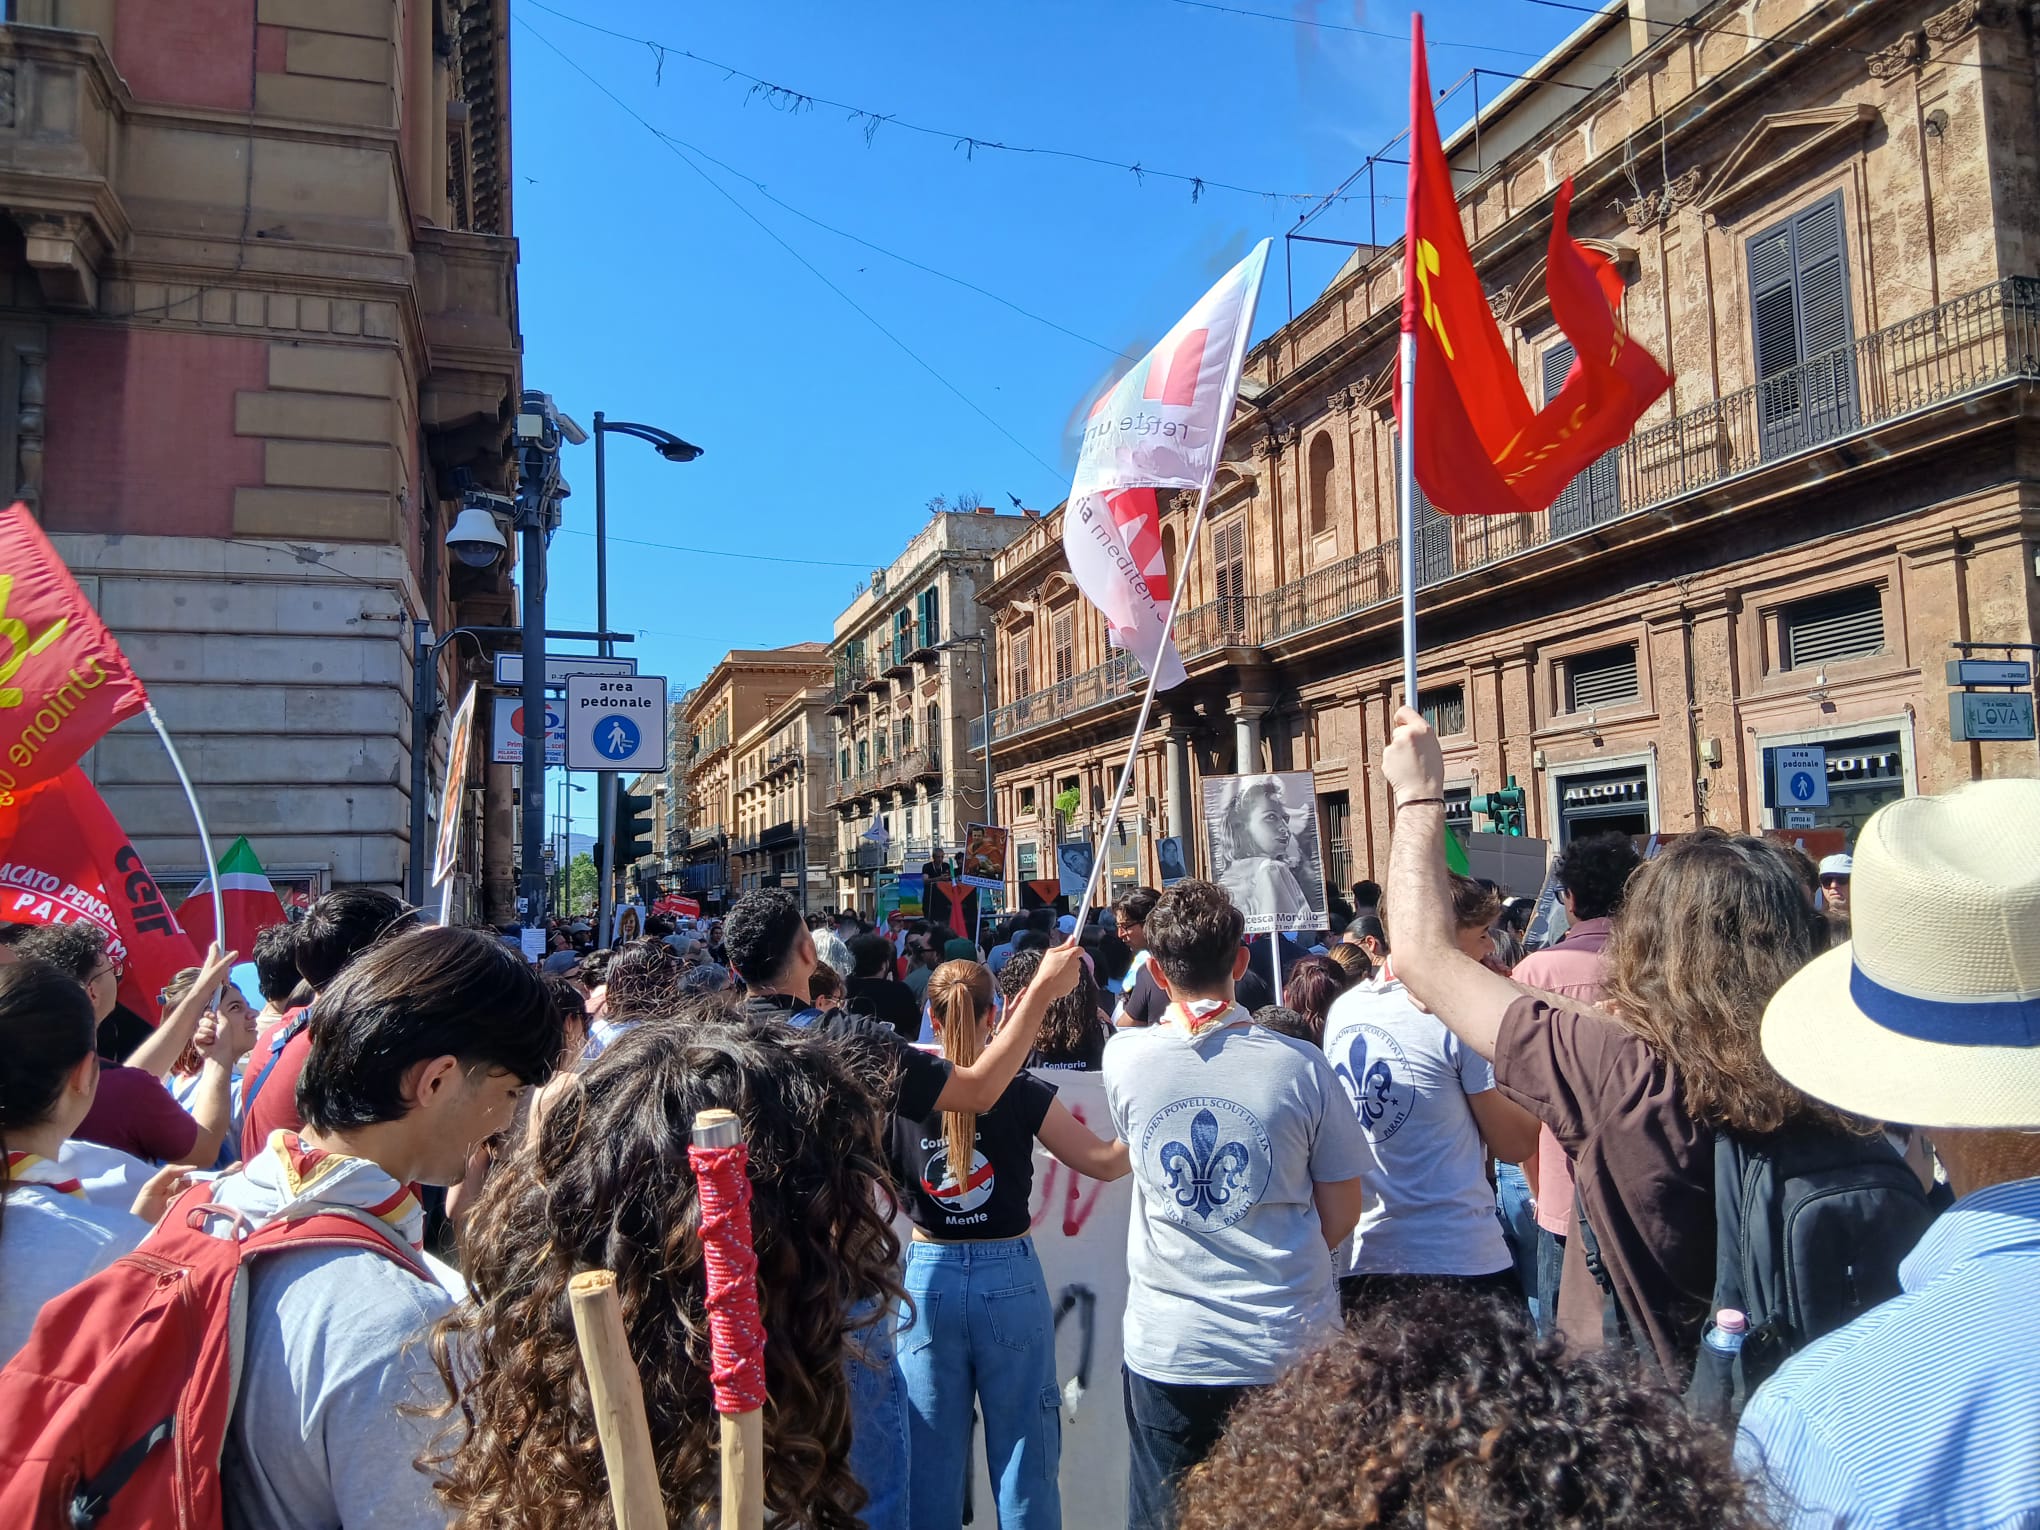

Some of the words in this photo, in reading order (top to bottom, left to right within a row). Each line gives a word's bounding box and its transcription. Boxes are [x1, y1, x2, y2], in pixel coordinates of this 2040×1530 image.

[600, 682, 633, 692] area
[581, 696, 652, 709] pedonale
[1977, 708, 2020, 725] LOVA
[1783, 760, 1819, 769] pedonale
[1825, 752, 1893, 774] COTT
[1566, 781, 1641, 800] ALCOTT
[1246, 915, 1274, 924] cesca
[1276, 912, 1319, 922] Morvillo
[1042, 1060, 1088, 1071] Contraria
[1164, 1099, 1208, 1118] POWELL
[1209, 1099, 1246, 1118] SCOUT
[1243, 1116, 1270, 1152] ITALIA
[1383, 1112, 1406, 1137] PARATI
[945, 1212, 989, 1226] Mente
[1222, 1199, 1253, 1227] PARATI
